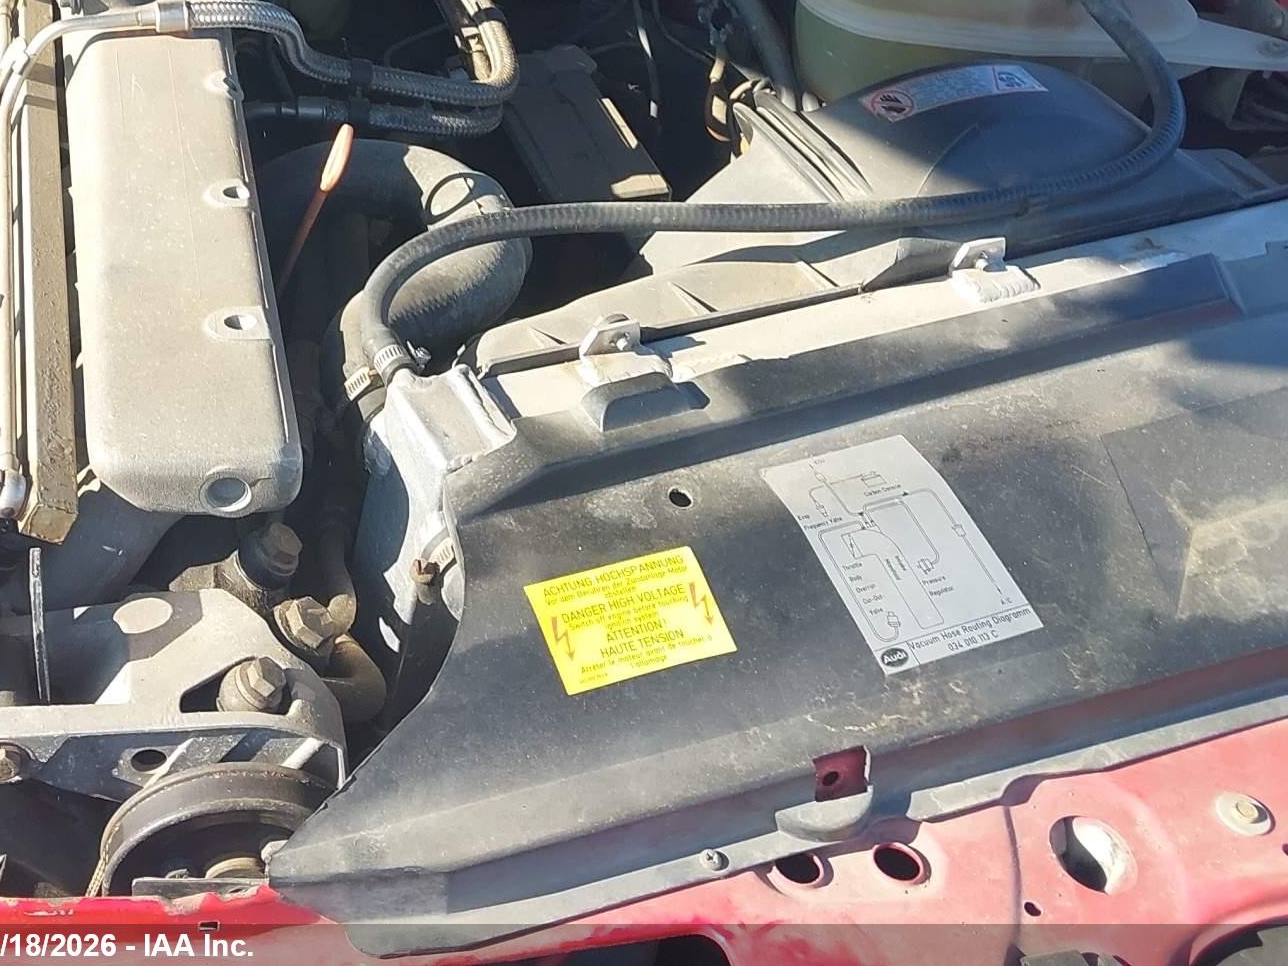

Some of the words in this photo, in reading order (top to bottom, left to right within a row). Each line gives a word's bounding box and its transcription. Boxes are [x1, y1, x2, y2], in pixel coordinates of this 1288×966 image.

[544, 577, 593, 598] ACHTUNG
[562, 603, 607, 624] DANGER
[608, 596, 634, 611] HIGH
[636, 583, 686, 602] VOLTAGE
[907, 635, 941, 650] Vacuum
[940, 628, 962, 641] Hose
[961, 619, 992, 634] Routing
[991, 608, 1032, 624] Diagramm
[947, 641, 964, 651] 034
[990, 630, 1000, 639] C
[600, 640, 637, 659] HAUTE
[638, 628, 684, 649] TENSION
[882, 650, 908, 665] Audi
